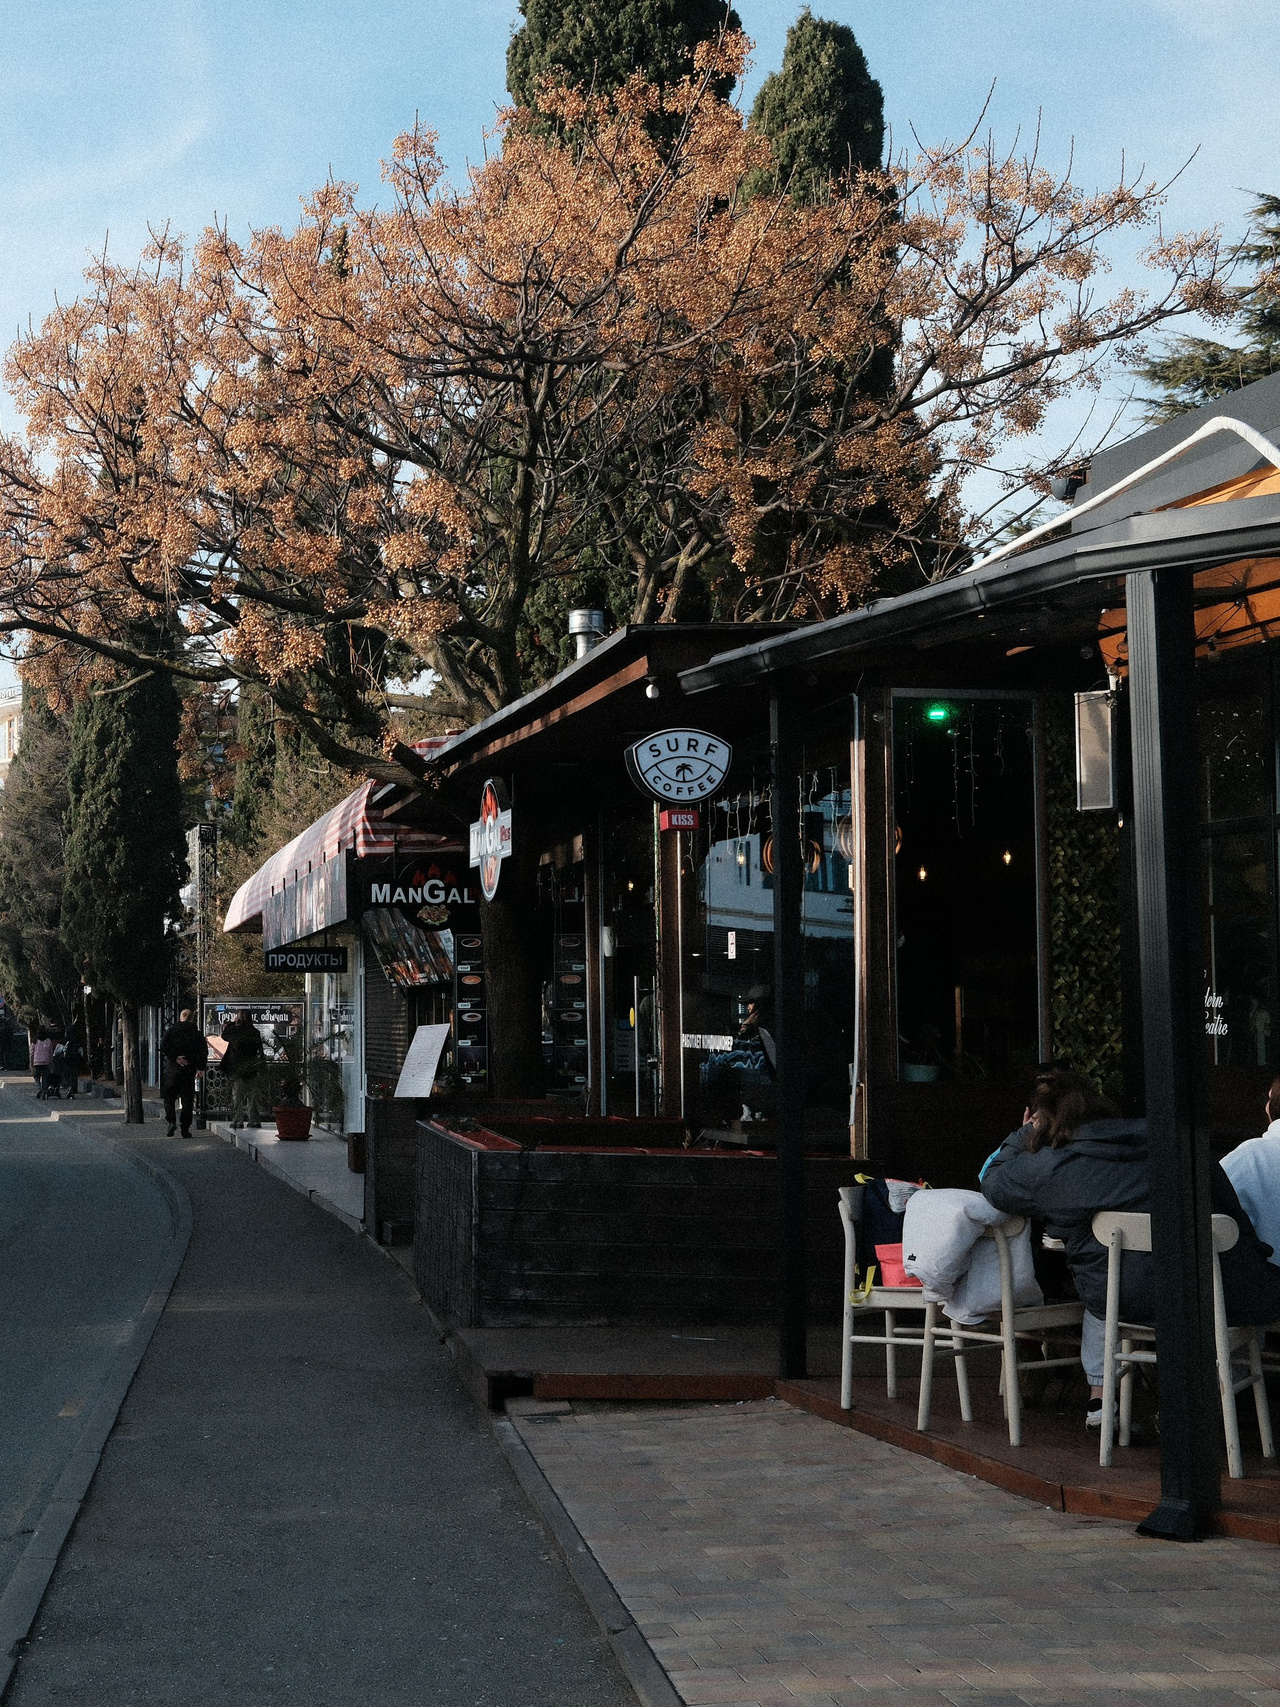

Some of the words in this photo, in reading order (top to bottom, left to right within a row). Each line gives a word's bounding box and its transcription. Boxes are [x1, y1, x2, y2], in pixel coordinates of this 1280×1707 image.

[648, 737, 719, 758] SURF
[652, 775, 716, 796] COFFEE
[671, 814, 694, 826] KISS
[268, 953, 343, 969] ПРОДУКТЫ
